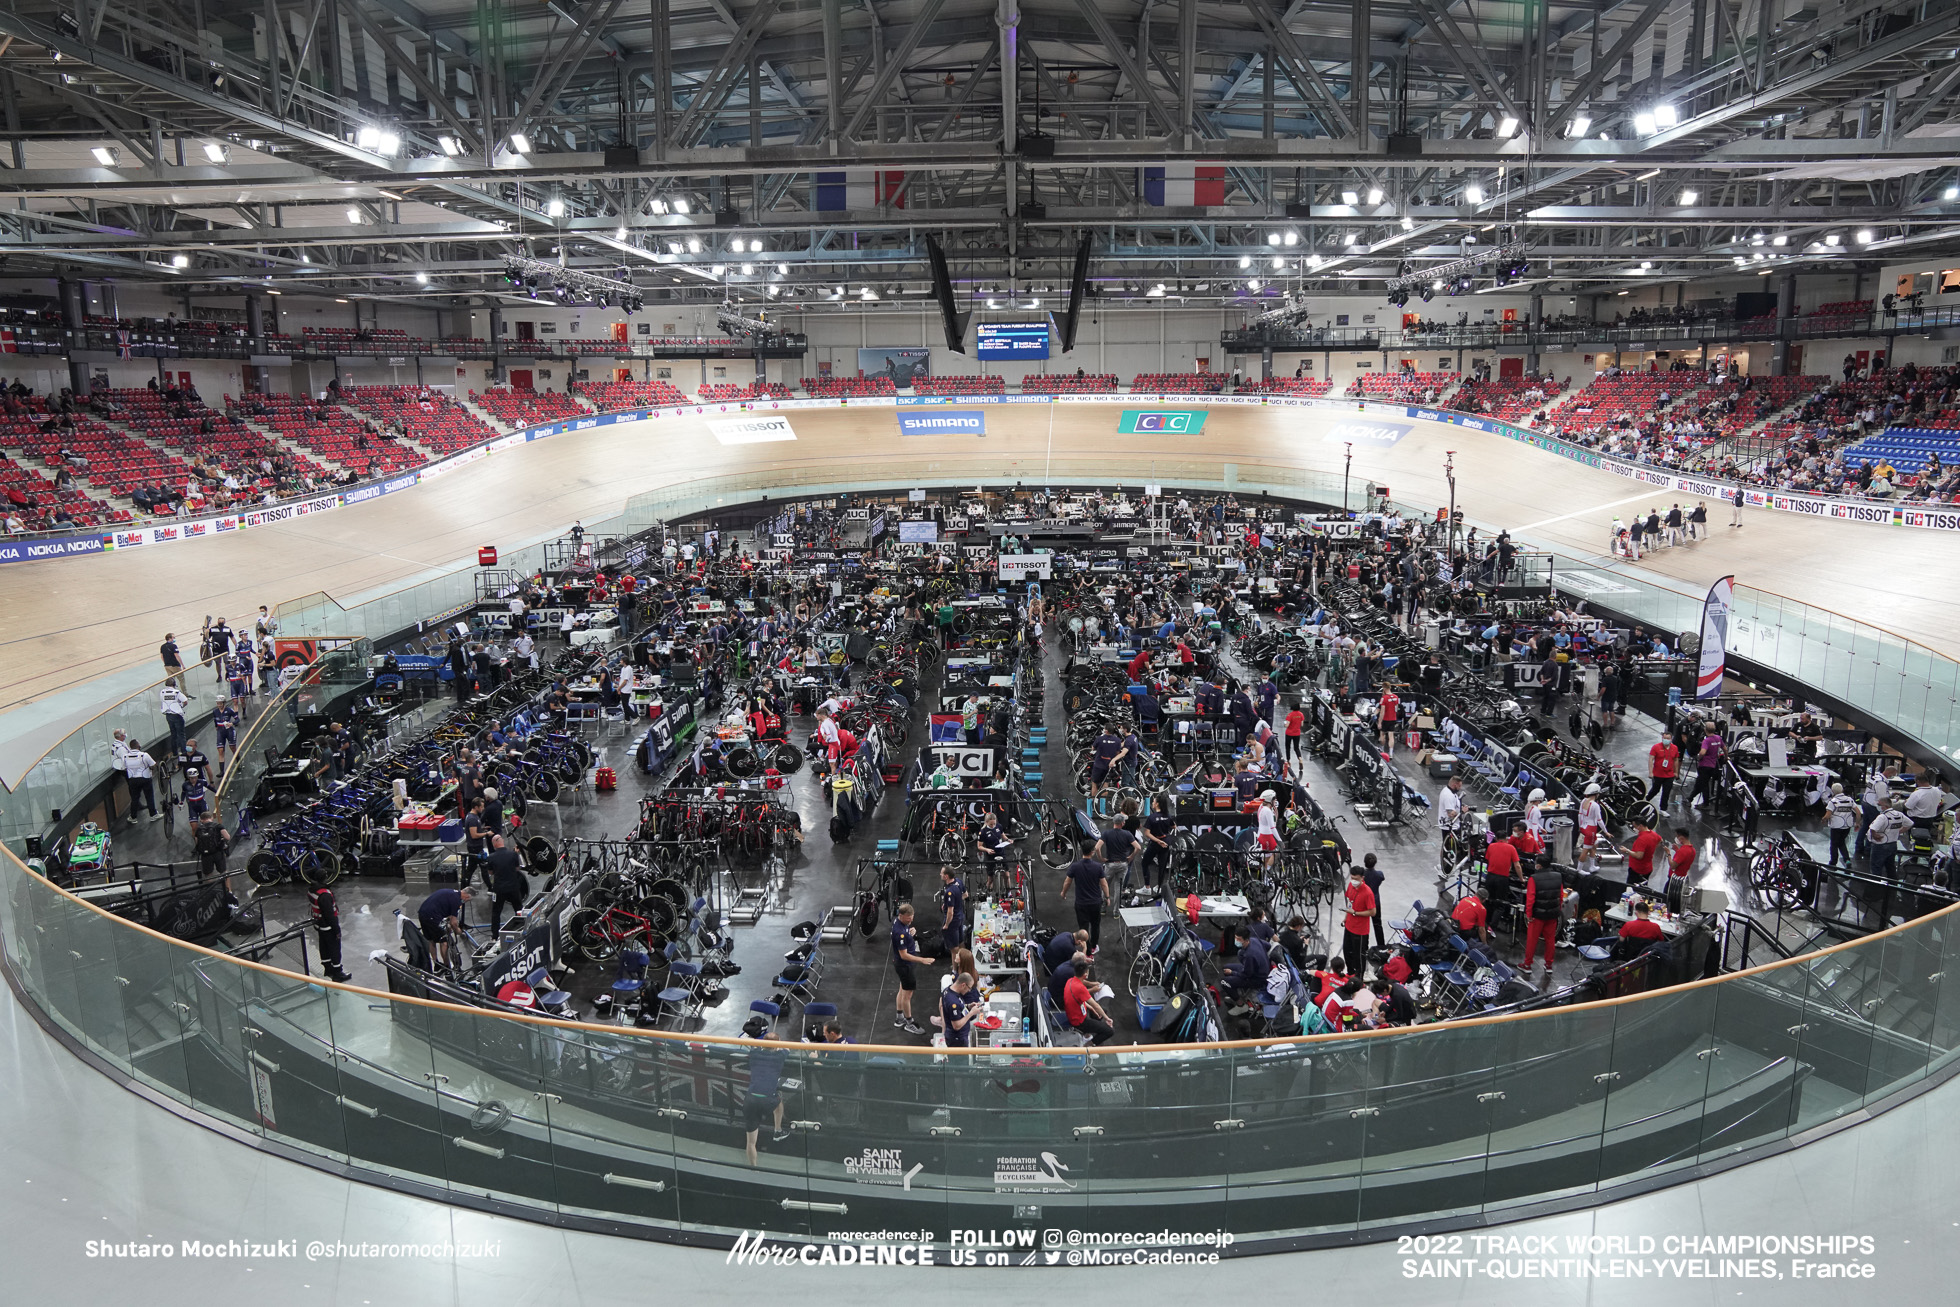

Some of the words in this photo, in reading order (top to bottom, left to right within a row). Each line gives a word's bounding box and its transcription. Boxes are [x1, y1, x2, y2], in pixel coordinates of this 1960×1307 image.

[616, 413, 638, 423] Santini
[1416, 410, 1438, 420] Santini
[576, 419, 597, 429] Santini
[735, 421, 786, 433] TISSOT
[904, 418, 979, 428] SHIMANO
[1142, 417, 1184, 428] CIC
[1462, 418, 1484, 429] Santini
[534, 427, 554, 439] Santini
[1335, 424, 1398, 441] NOKIA
[1610, 464, 1633, 478] TISSOT
[385, 476, 415, 493] SHIMANO
[1645, 472, 1670, 486] TISSOT
[346, 486, 380, 503] SHIMANO
[1688, 481, 1716, 496] TISSOT
[1746, 492, 1764, 502] BigMat
[308, 497, 336, 513] TISSOT
[1789, 500, 1826, 514] TISSOT
[260, 507, 292, 523] TISSOT
[1847, 506, 1890, 522] TISSOT
[184, 524, 205, 534] BigMat
[216, 519, 236, 530] BigMat
[949, 521, 967, 529] UCI
[1323, 524, 1350, 536] UCI
[117, 533, 142, 545] BigMat
[154, 528, 177, 540] BigMat
[28, 543, 65, 556] NOKIA
[67, 539, 101, 552] NOKIA
[864, 1149, 901, 1160] SAINT
[997, 1156, 1037, 1164] FÉDÉRATION
[844, 1157, 901, 1168] QUENTIN
[997, 1164, 1037, 1172] FRANÇAISE
[860, 1168, 902, 1176] YVELINES
